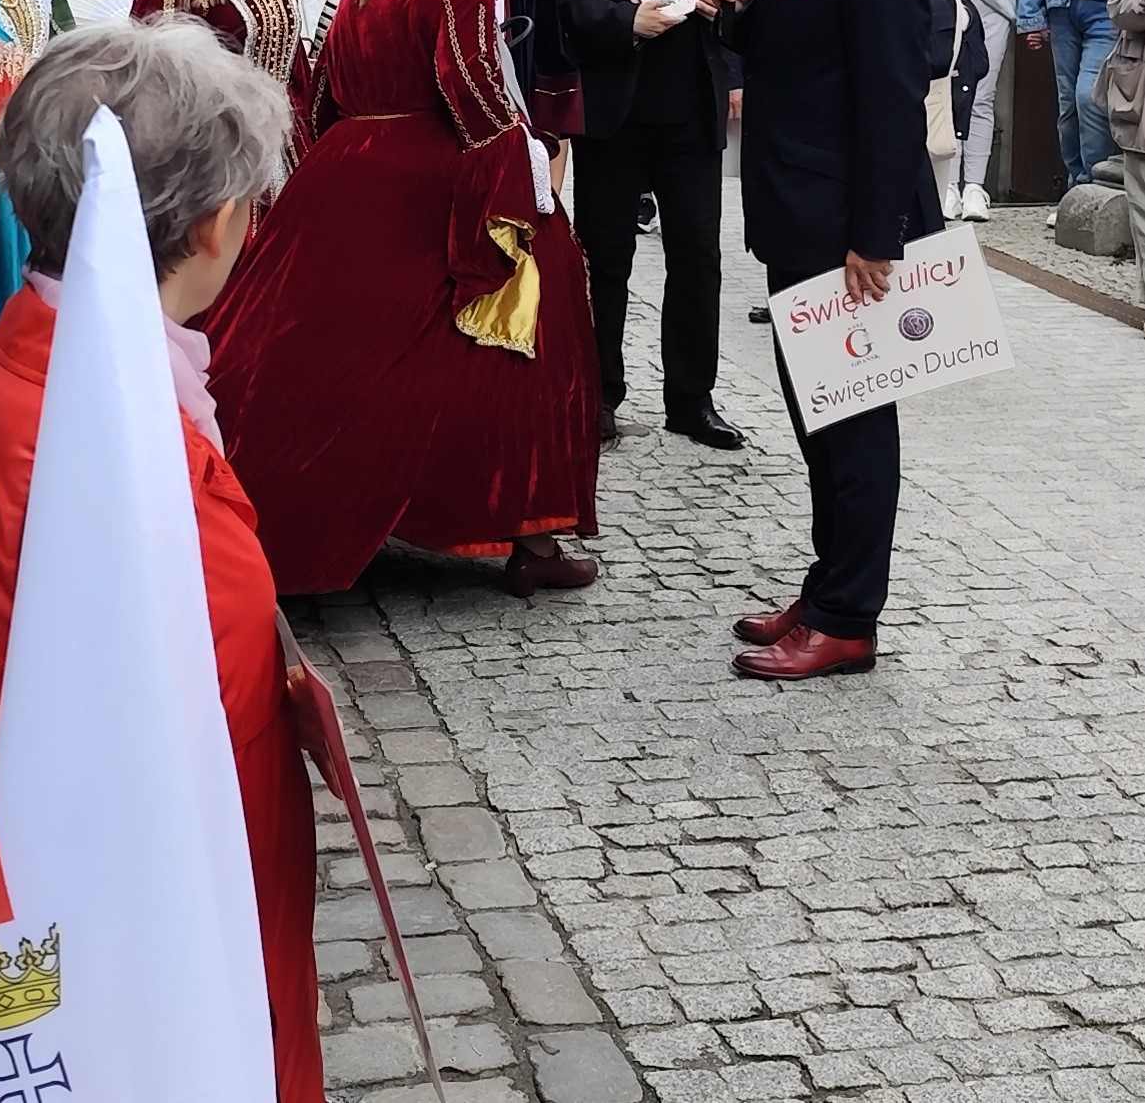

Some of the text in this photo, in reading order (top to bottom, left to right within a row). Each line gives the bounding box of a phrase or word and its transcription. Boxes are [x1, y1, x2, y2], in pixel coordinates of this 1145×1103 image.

[789, 289, 872, 335] Święt
[898, 255, 966, 294] ulicy
[810, 337, 1001, 415] Świętego Ducha
